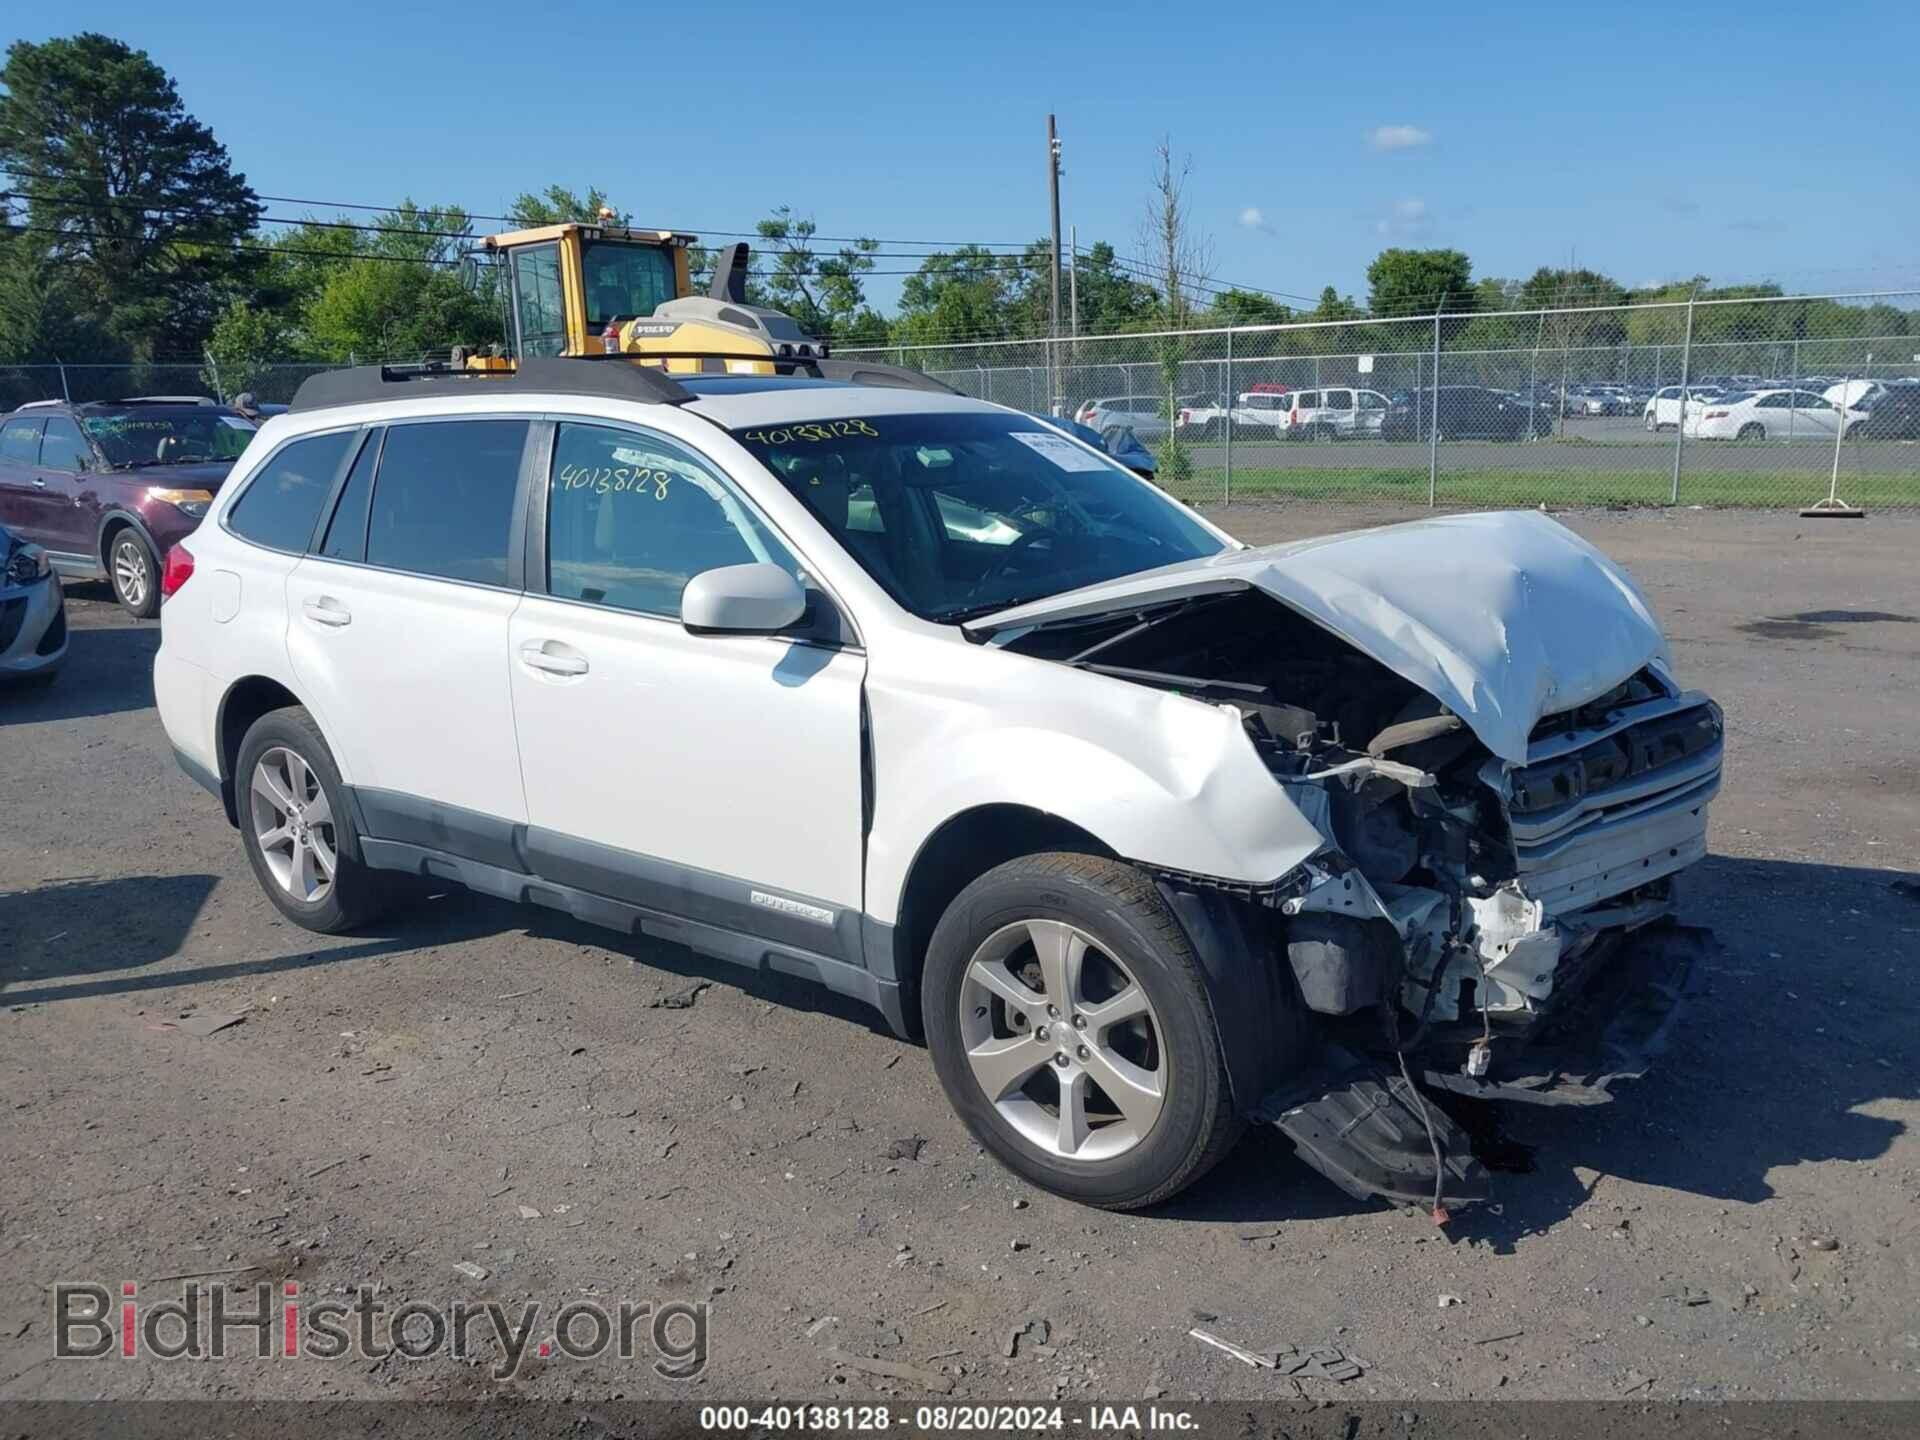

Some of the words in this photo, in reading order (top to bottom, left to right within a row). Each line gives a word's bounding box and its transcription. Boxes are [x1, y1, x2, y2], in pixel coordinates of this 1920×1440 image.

[637, 325, 675, 333] VOLVO
[745, 419, 879, 444] 40138128
[560, 463, 672, 501] 40138128
